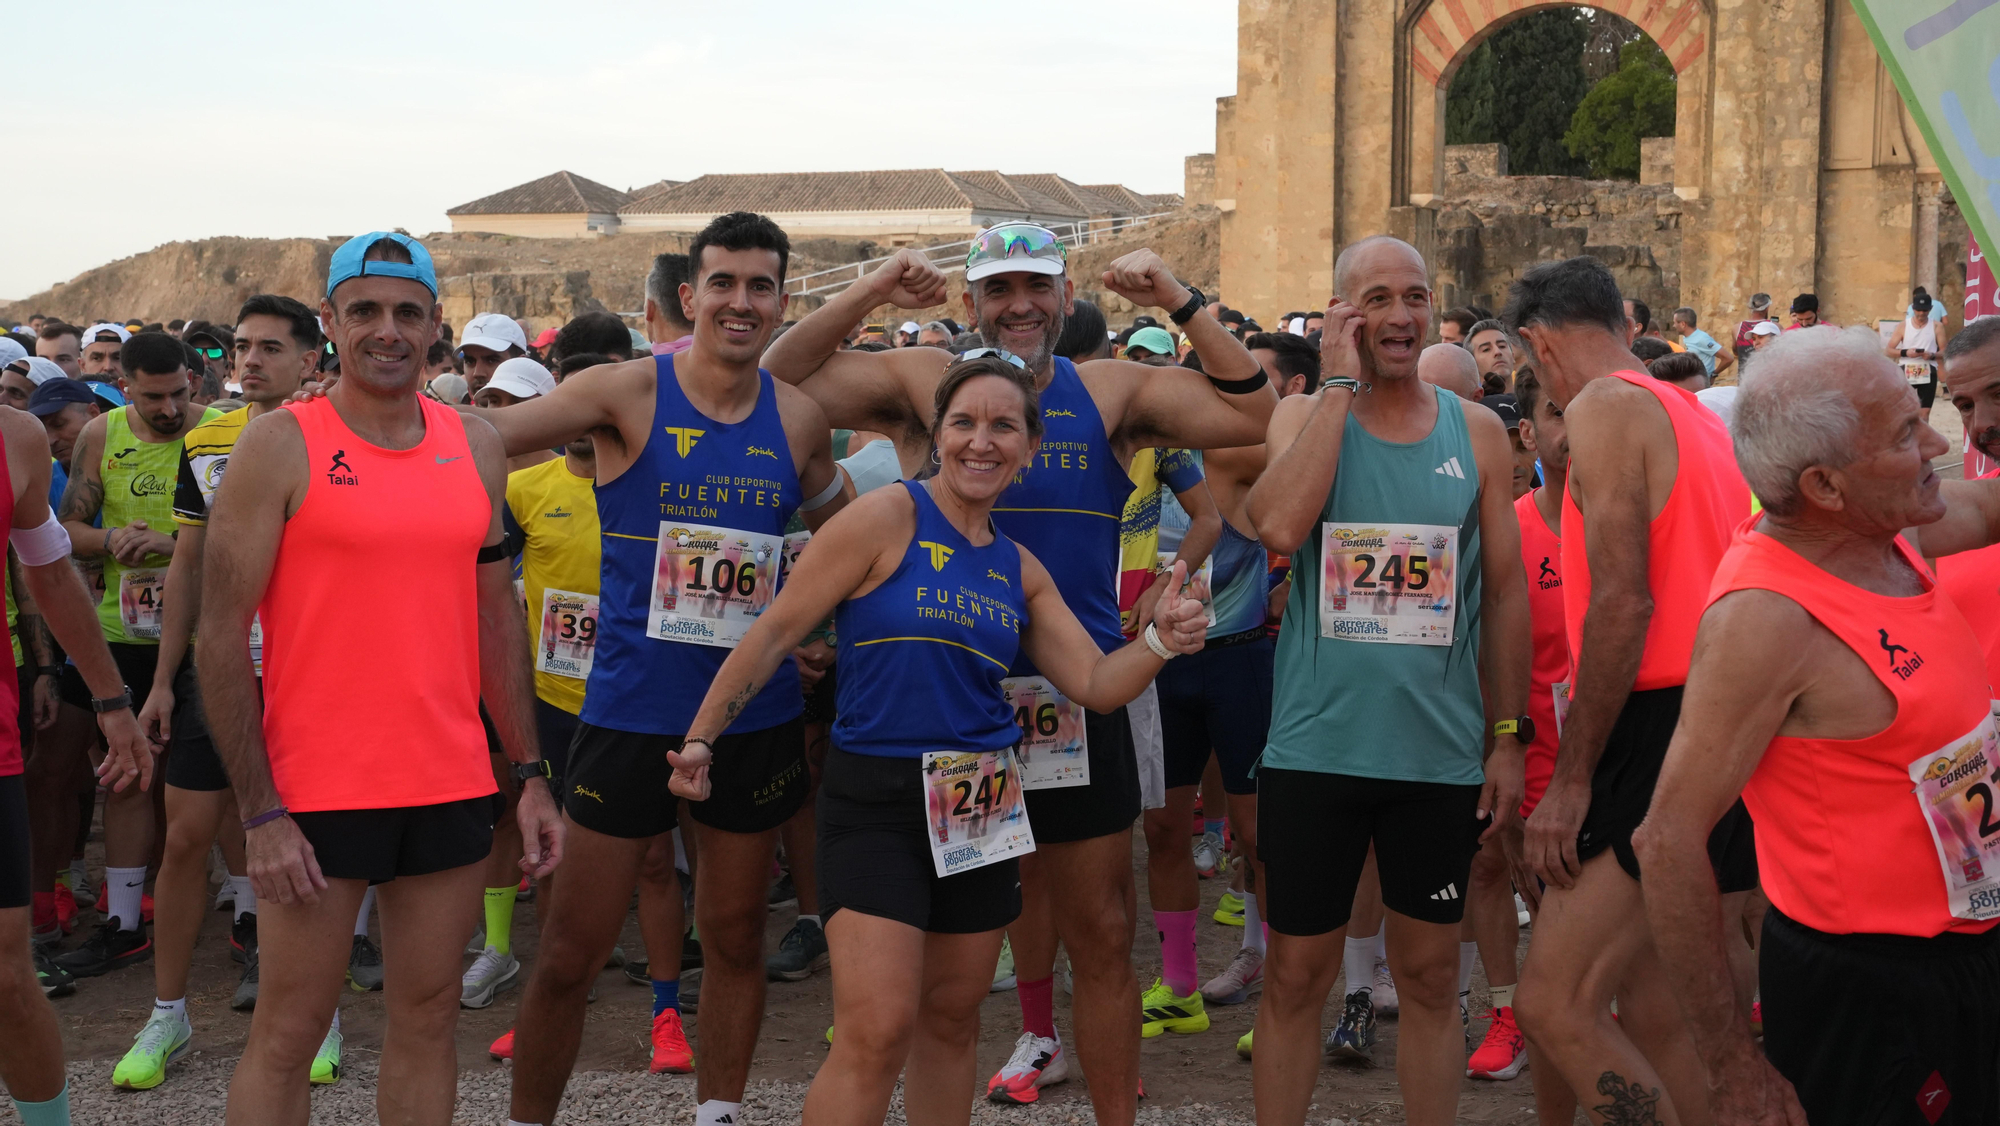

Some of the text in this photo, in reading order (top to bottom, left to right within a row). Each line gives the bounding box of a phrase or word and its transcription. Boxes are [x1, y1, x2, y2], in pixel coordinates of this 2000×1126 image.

[327, 474, 359, 486] Talai
[706, 475, 781, 490] CLUB DEPORTIVO
[660, 483, 780, 507] FUENTES
[660, 504, 717, 518] TRIATLÓN
[686, 556, 756, 596] 106
[1354, 554, 1429, 590] 245
[1537, 577, 1562, 590] Talai
[960, 586, 978, 600] CLUB
[917, 587, 1019, 634] FUENTES
[917, 607, 974, 628] TRIATLÓN
[561, 614, 596, 641] 39
[661, 619, 707, 630] creras
[661, 624, 714, 637] populares
[1333, 620, 1379, 628] carreras
[1334, 626, 1388, 635] populares
[1891, 652, 1924, 681] Talai
[753, 764, 801, 799] FUENTES
[952, 768, 1006, 816] 247
[1966, 766, 2000, 838] 2
[943, 846, 975, 860] carreras
[945, 850, 983, 868] populares
